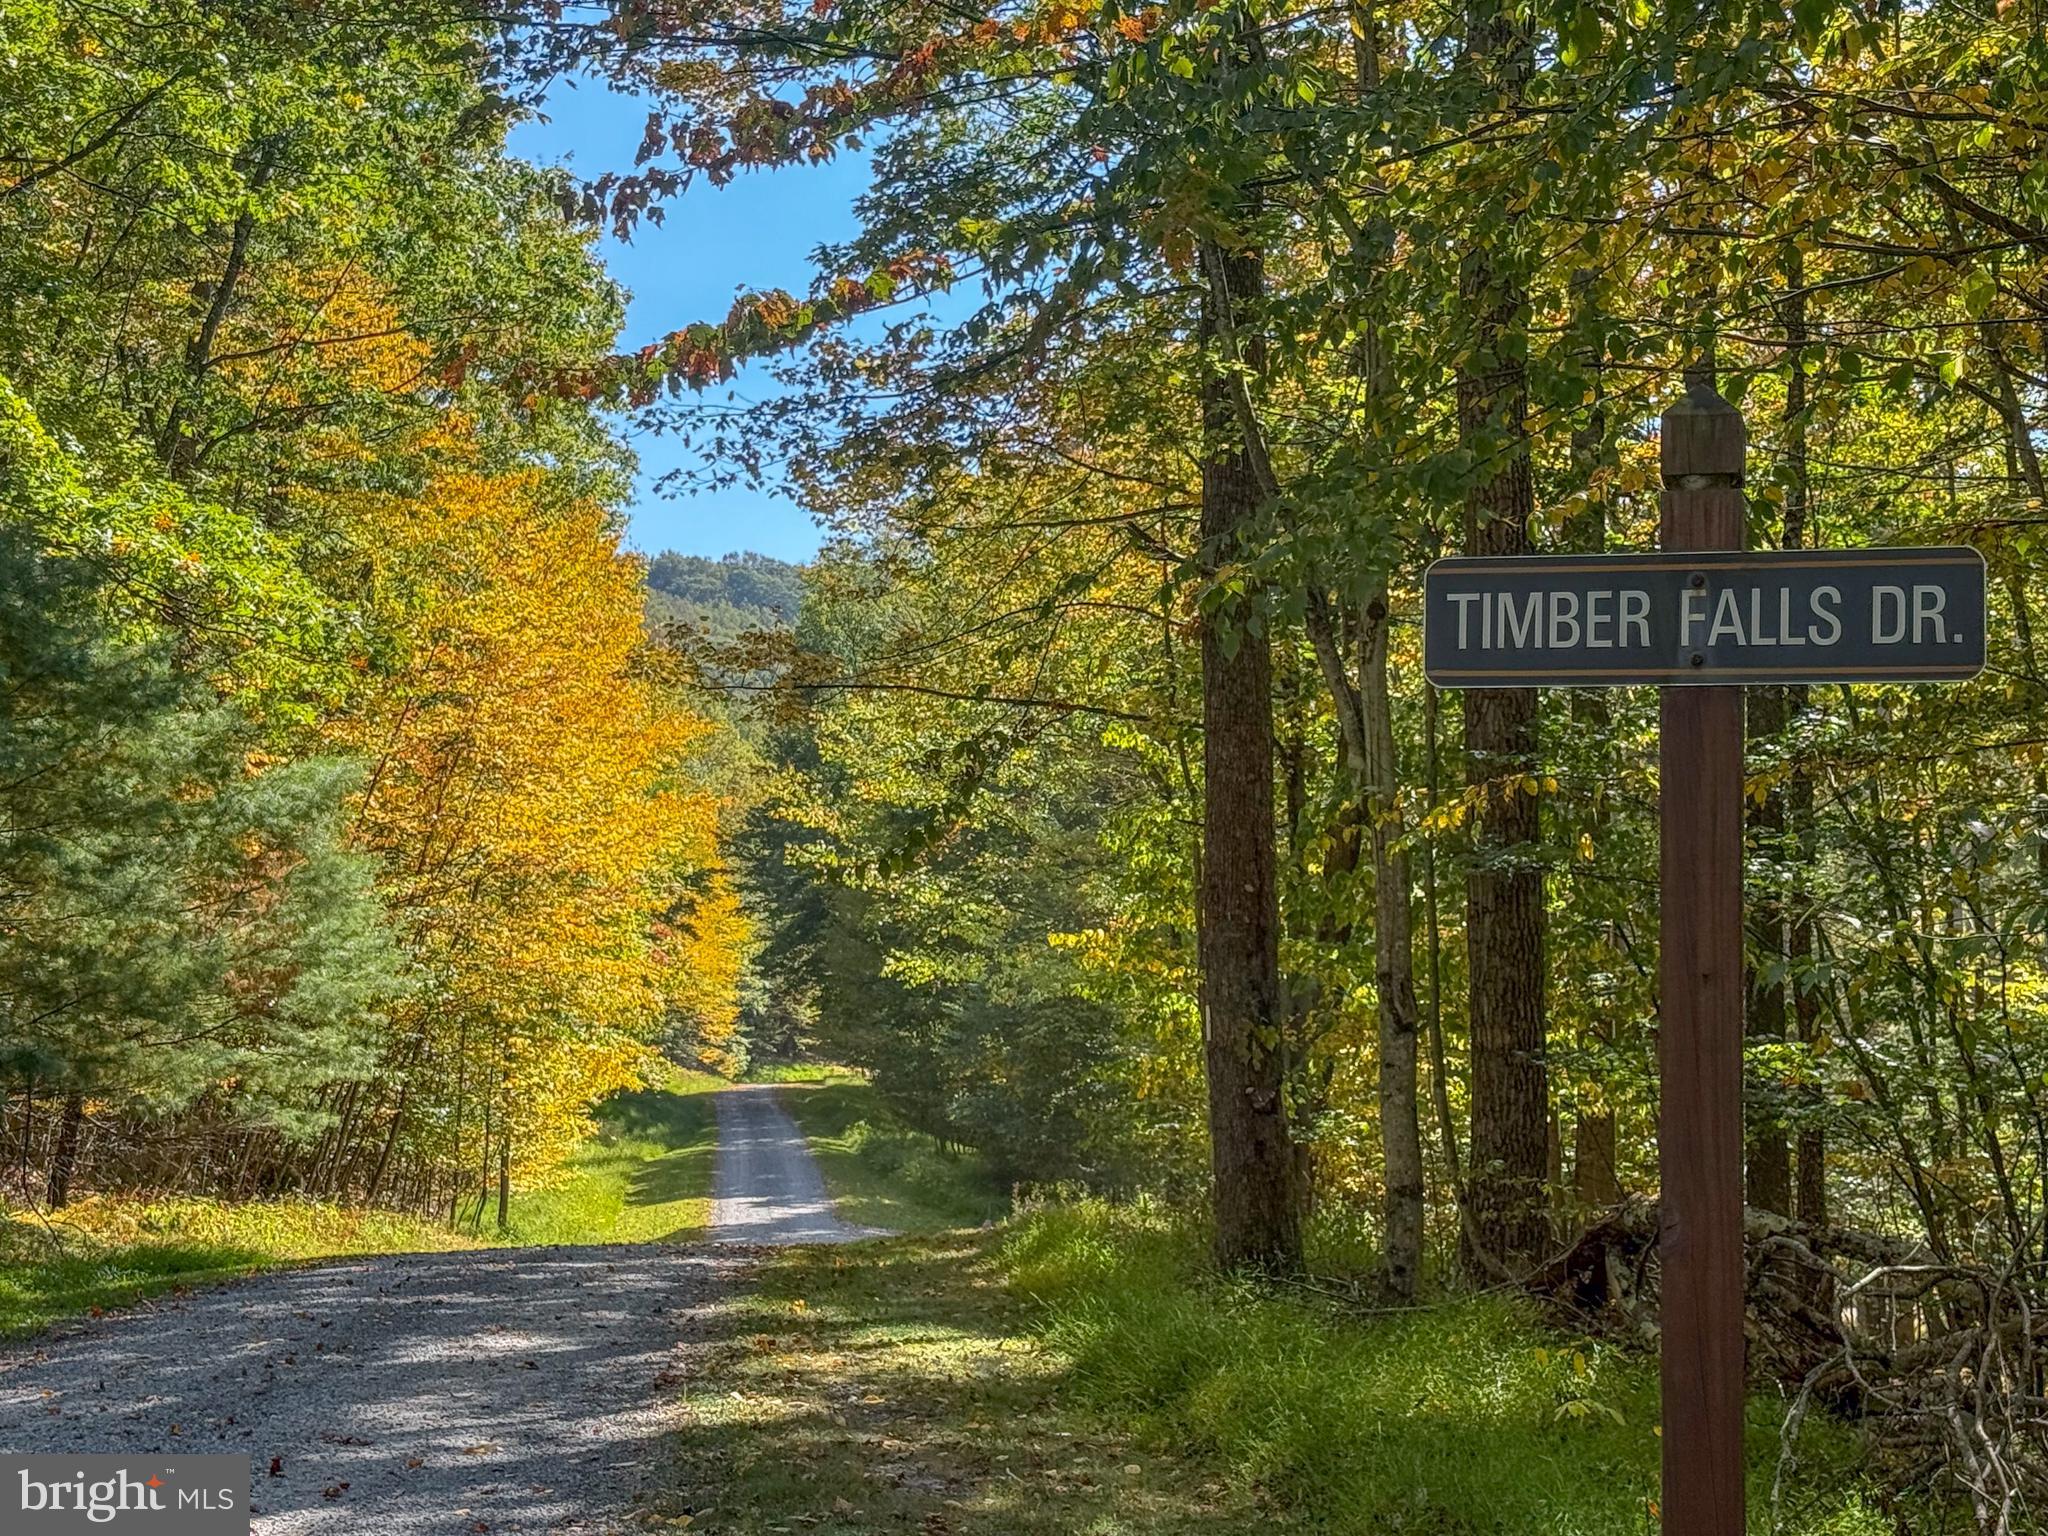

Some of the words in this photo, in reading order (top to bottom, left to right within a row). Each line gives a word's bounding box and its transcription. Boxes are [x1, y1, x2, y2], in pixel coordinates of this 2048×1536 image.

[1446, 590, 1652, 650] TIMBER
[1680, 585, 1843, 648] FALLS
[1871, 584, 1964, 645] DR.
